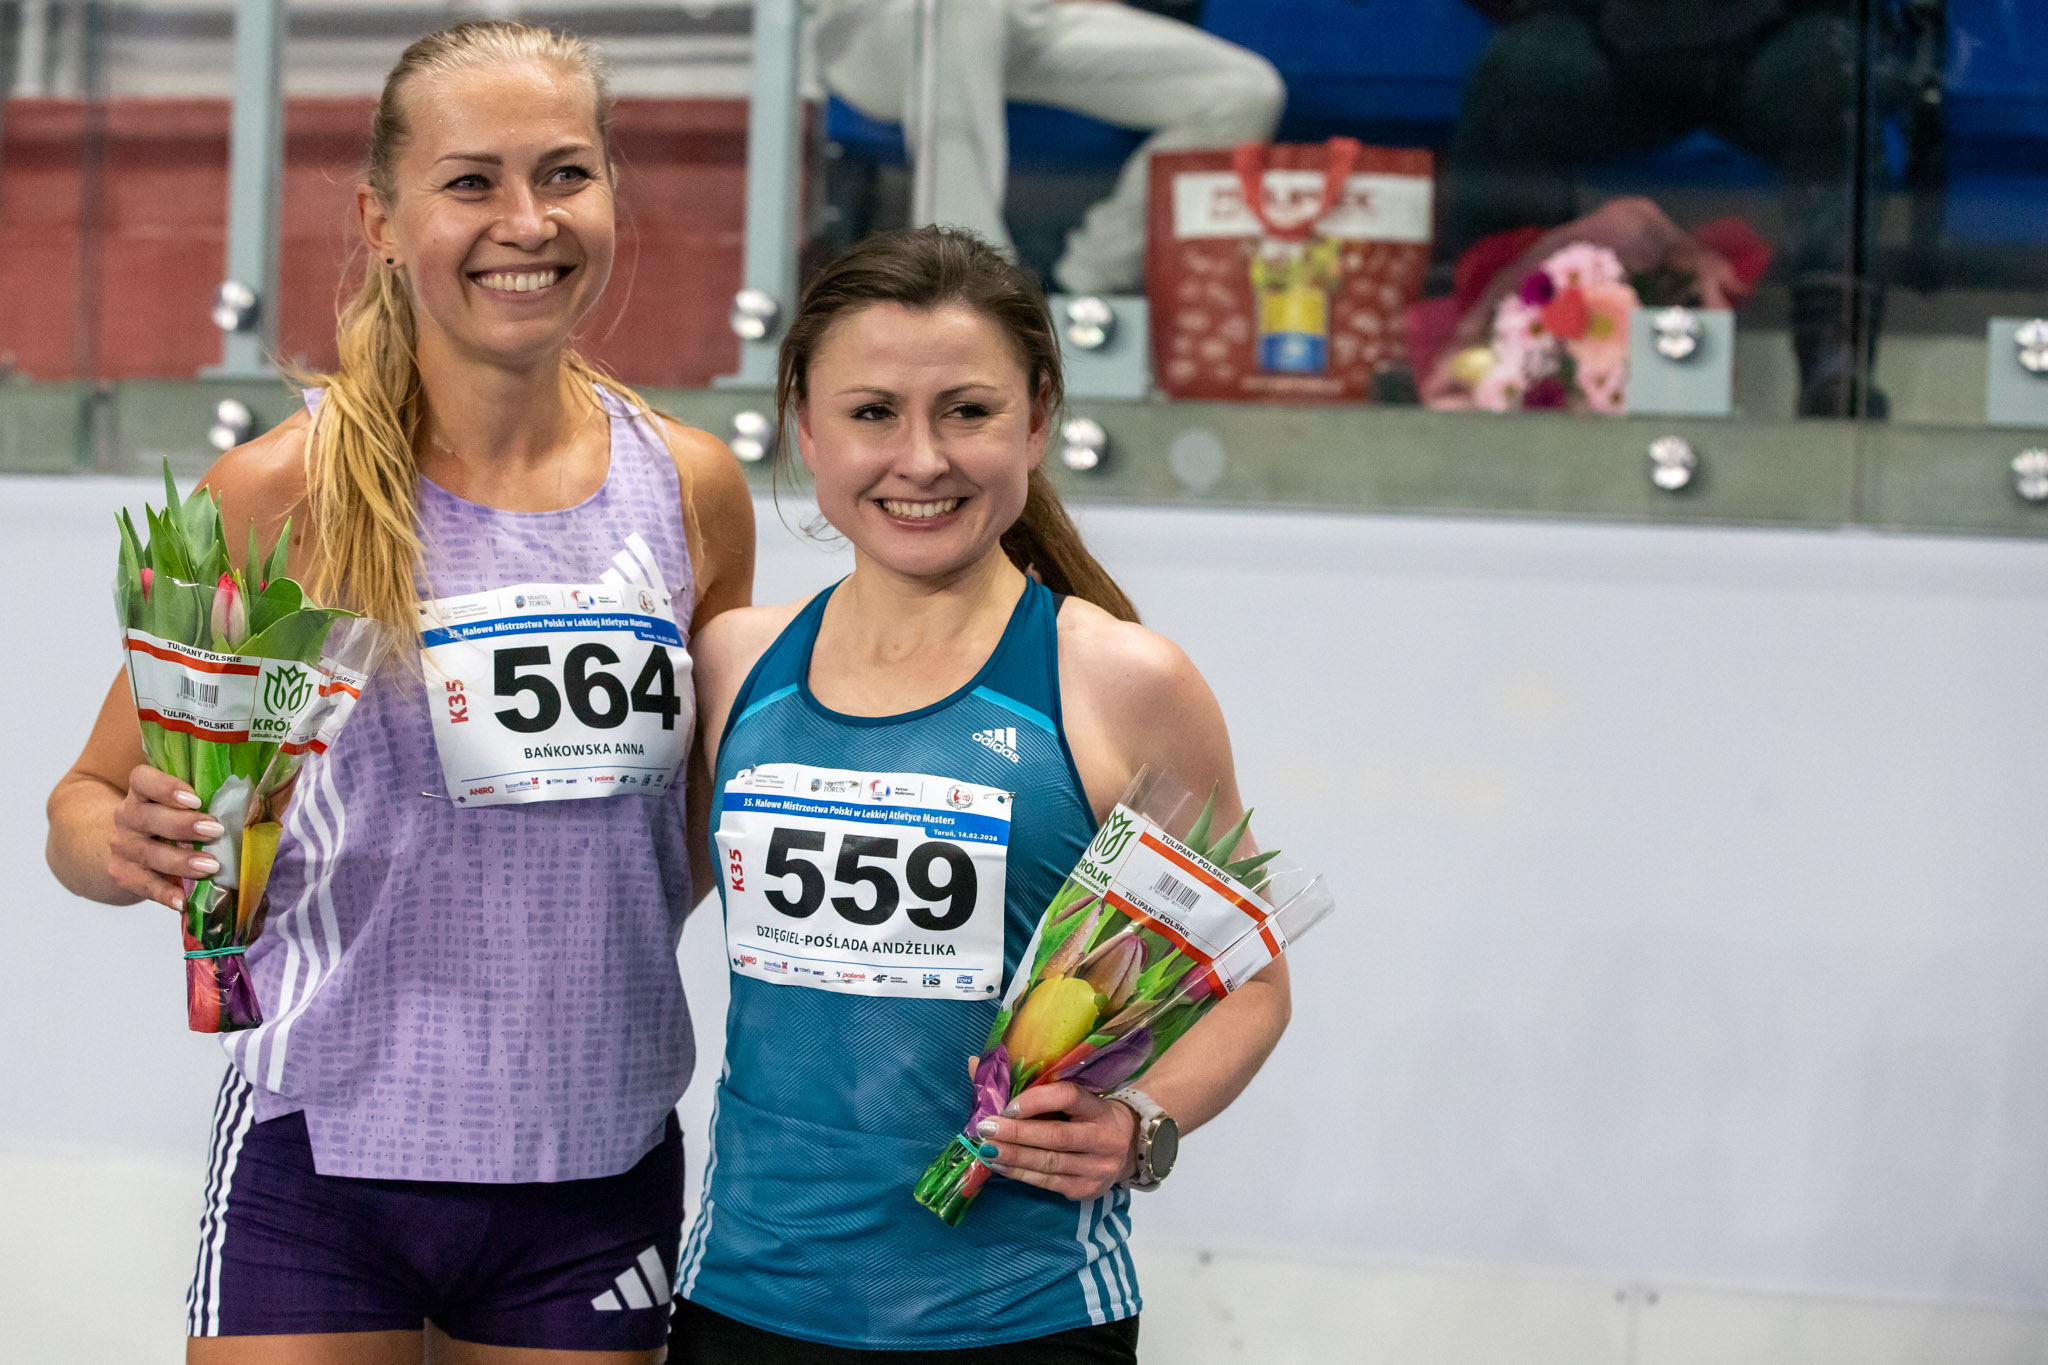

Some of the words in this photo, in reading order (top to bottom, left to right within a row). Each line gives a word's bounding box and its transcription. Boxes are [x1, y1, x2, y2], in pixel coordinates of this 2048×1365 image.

[462, 626, 494, 637] Halowe
[495, 620, 543, 632] Mistrzostwa
[544, 618, 565, 628] Polski
[566, 619, 573, 627] w
[574, 618, 600, 629] Lekkiej
[601, 618, 629, 628] Atletyce
[630, 618, 652, 629] Masters
[167, 641, 202, 658] TULIPANY
[204, 653, 242, 663] POLSKIE
[494, 643, 681, 733] 564
[445, 679, 469, 724] K35
[198, 719, 234, 730] POLSKIE
[524, 743, 612, 759] BAŃKOWSKA
[615, 743, 645, 756] ANNA
[972, 732, 1020, 763] adidas
[470, 785, 494, 796] ANIRO
[505, 780, 531, 789] InterRisk
[823, 784, 846, 793] TORUŃ
[743, 798, 754, 807] 35.
[755, 798, 781, 809] Halowe
[782, 801, 828, 814] Mistrzostwa
[829, 806, 853, 817] Polski
[862, 808, 888, 821] Lekkiej
[889, 811, 921, 824] Atletyce
[922, 813, 955, 825] Masters
[934, 829, 956, 838] Toruń,
[958, 831, 998, 842] 14.02.2026
[1161, 834, 1198, 862] TULIPANY
[1197, 858, 1231, 884] POLSKIE
[729, 848, 745, 892] K35
[764, 826, 978, 931] 559
[1125, 891, 1160, 917] TULIPANY
[1159, 914, 1191, 938] POLSKIE
[756, 924, 869, 953] DZIĘGIEL-POŚLADA
[872, 938, 956, 956] ANDŻELIKA
[842, 971, 866, 979] polanik
[872, 974, 888, 983] 4F
[922, 974, 941, 986] HS
